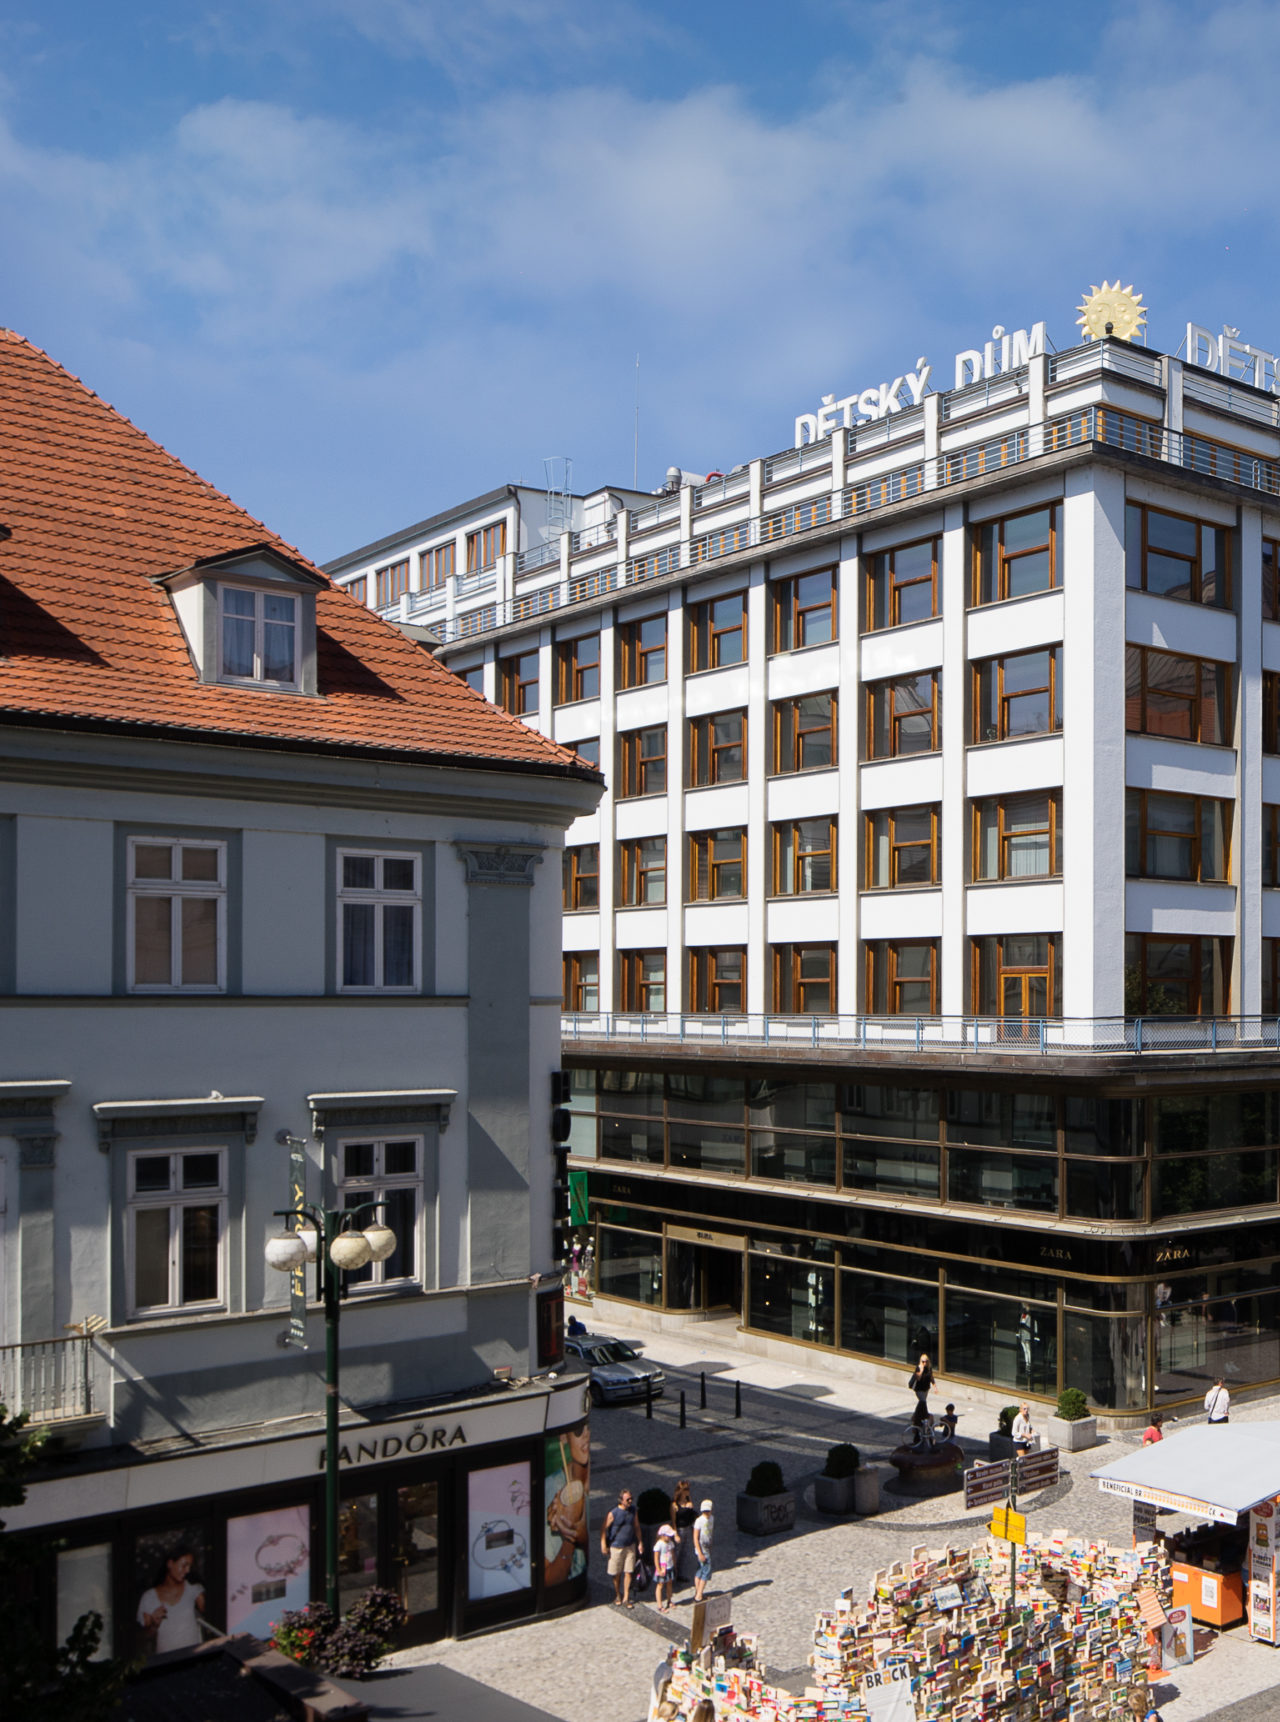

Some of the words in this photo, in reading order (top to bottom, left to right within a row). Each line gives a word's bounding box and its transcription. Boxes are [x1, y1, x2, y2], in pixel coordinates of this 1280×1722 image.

[795, 356, 933, 449] DĚTSKÝ
[955, 321, 1047, 390] DŮM
[1040, 1246, 1073, 1260] ZARA
[1155, 1249, 1190, 1262] ZARA
[1102, 1480, 1133, 1496] BENEFICIAL
